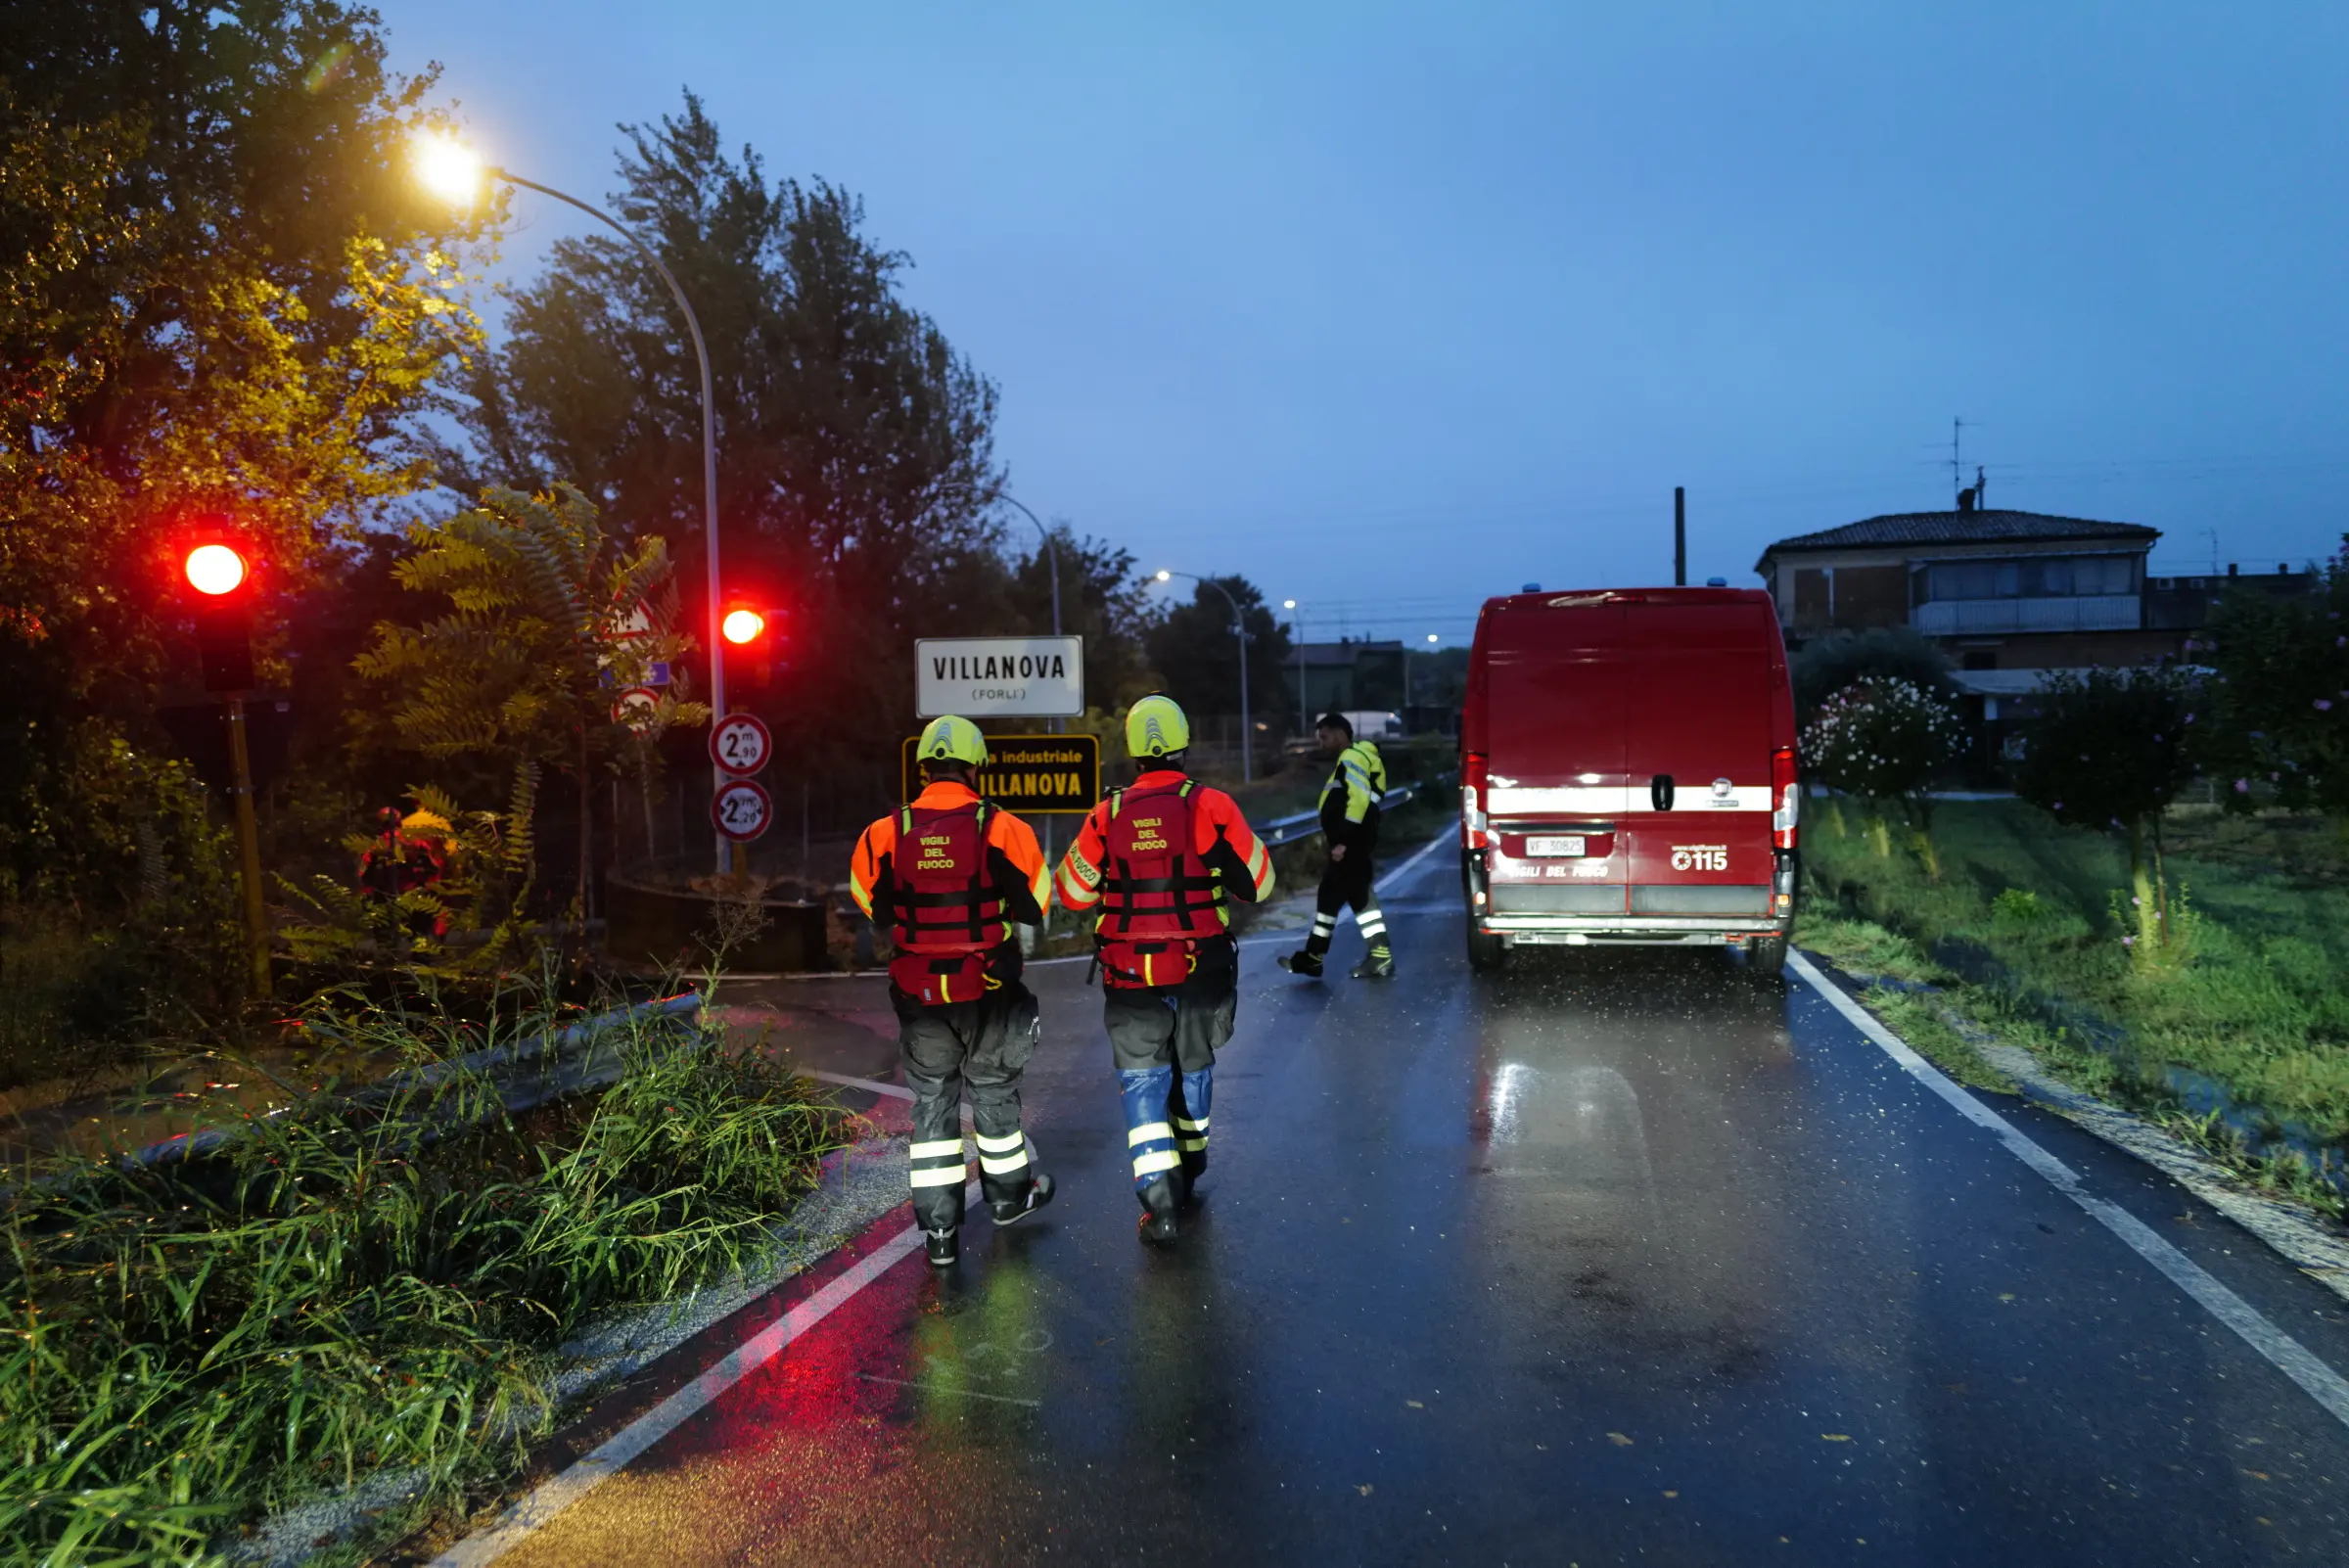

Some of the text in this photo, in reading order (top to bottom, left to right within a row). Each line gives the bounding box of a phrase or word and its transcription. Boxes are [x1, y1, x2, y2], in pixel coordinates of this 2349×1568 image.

[934, 655, 1065, 680] VILLANOVA
[1002, 750, 1083, 763] industriale
[980, 773, 1082, 796] ILLANOVA
[1132, 818, 1162, 828] VIGILI
[1138, 830, 1159, 839] DEL
[920, 836, 949, 846] VIGILI
[1131, 840, 1167, 852] FUOCO
[924, 849, 945, 857] DEL
[917, 859, 954, 870] FUOCO
[1691, 852, 1727, 870] 115
[1074, 856, 1096, 881] FUOCO
[1510, 866, 1541, 877] IGILI
[1546, 866, 1566, 877] DEL
